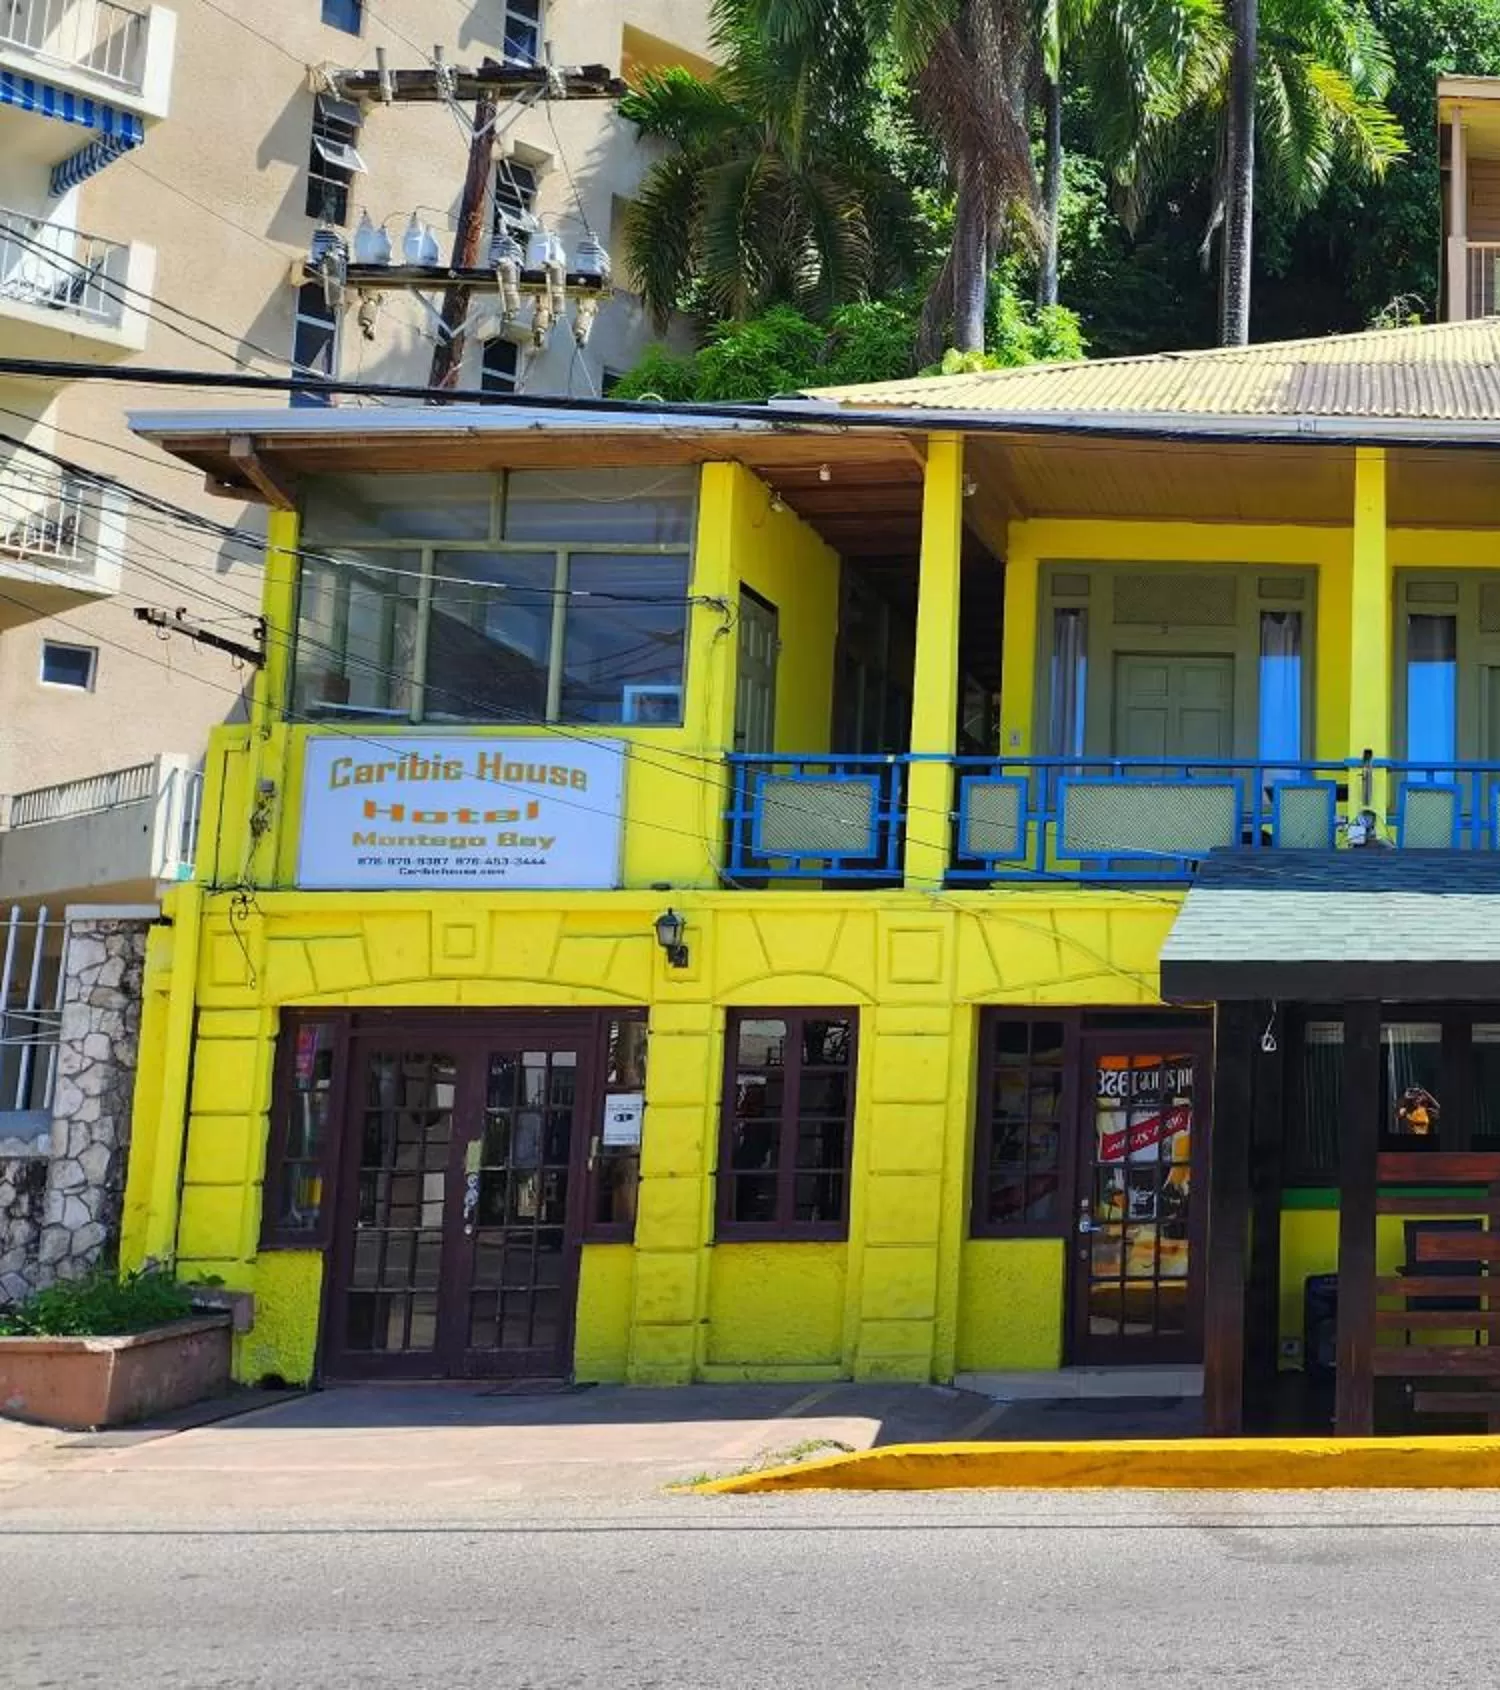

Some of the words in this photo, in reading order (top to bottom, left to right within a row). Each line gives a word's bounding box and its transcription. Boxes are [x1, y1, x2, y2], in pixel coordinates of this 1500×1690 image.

[329, 752, 463, 790] Caribic
[476, 752, 588, 791] House
[363, 800, 539, 824] Hotel
[351, 832, 487, 850] Montego
[496, 832, 557, 850] Bay
